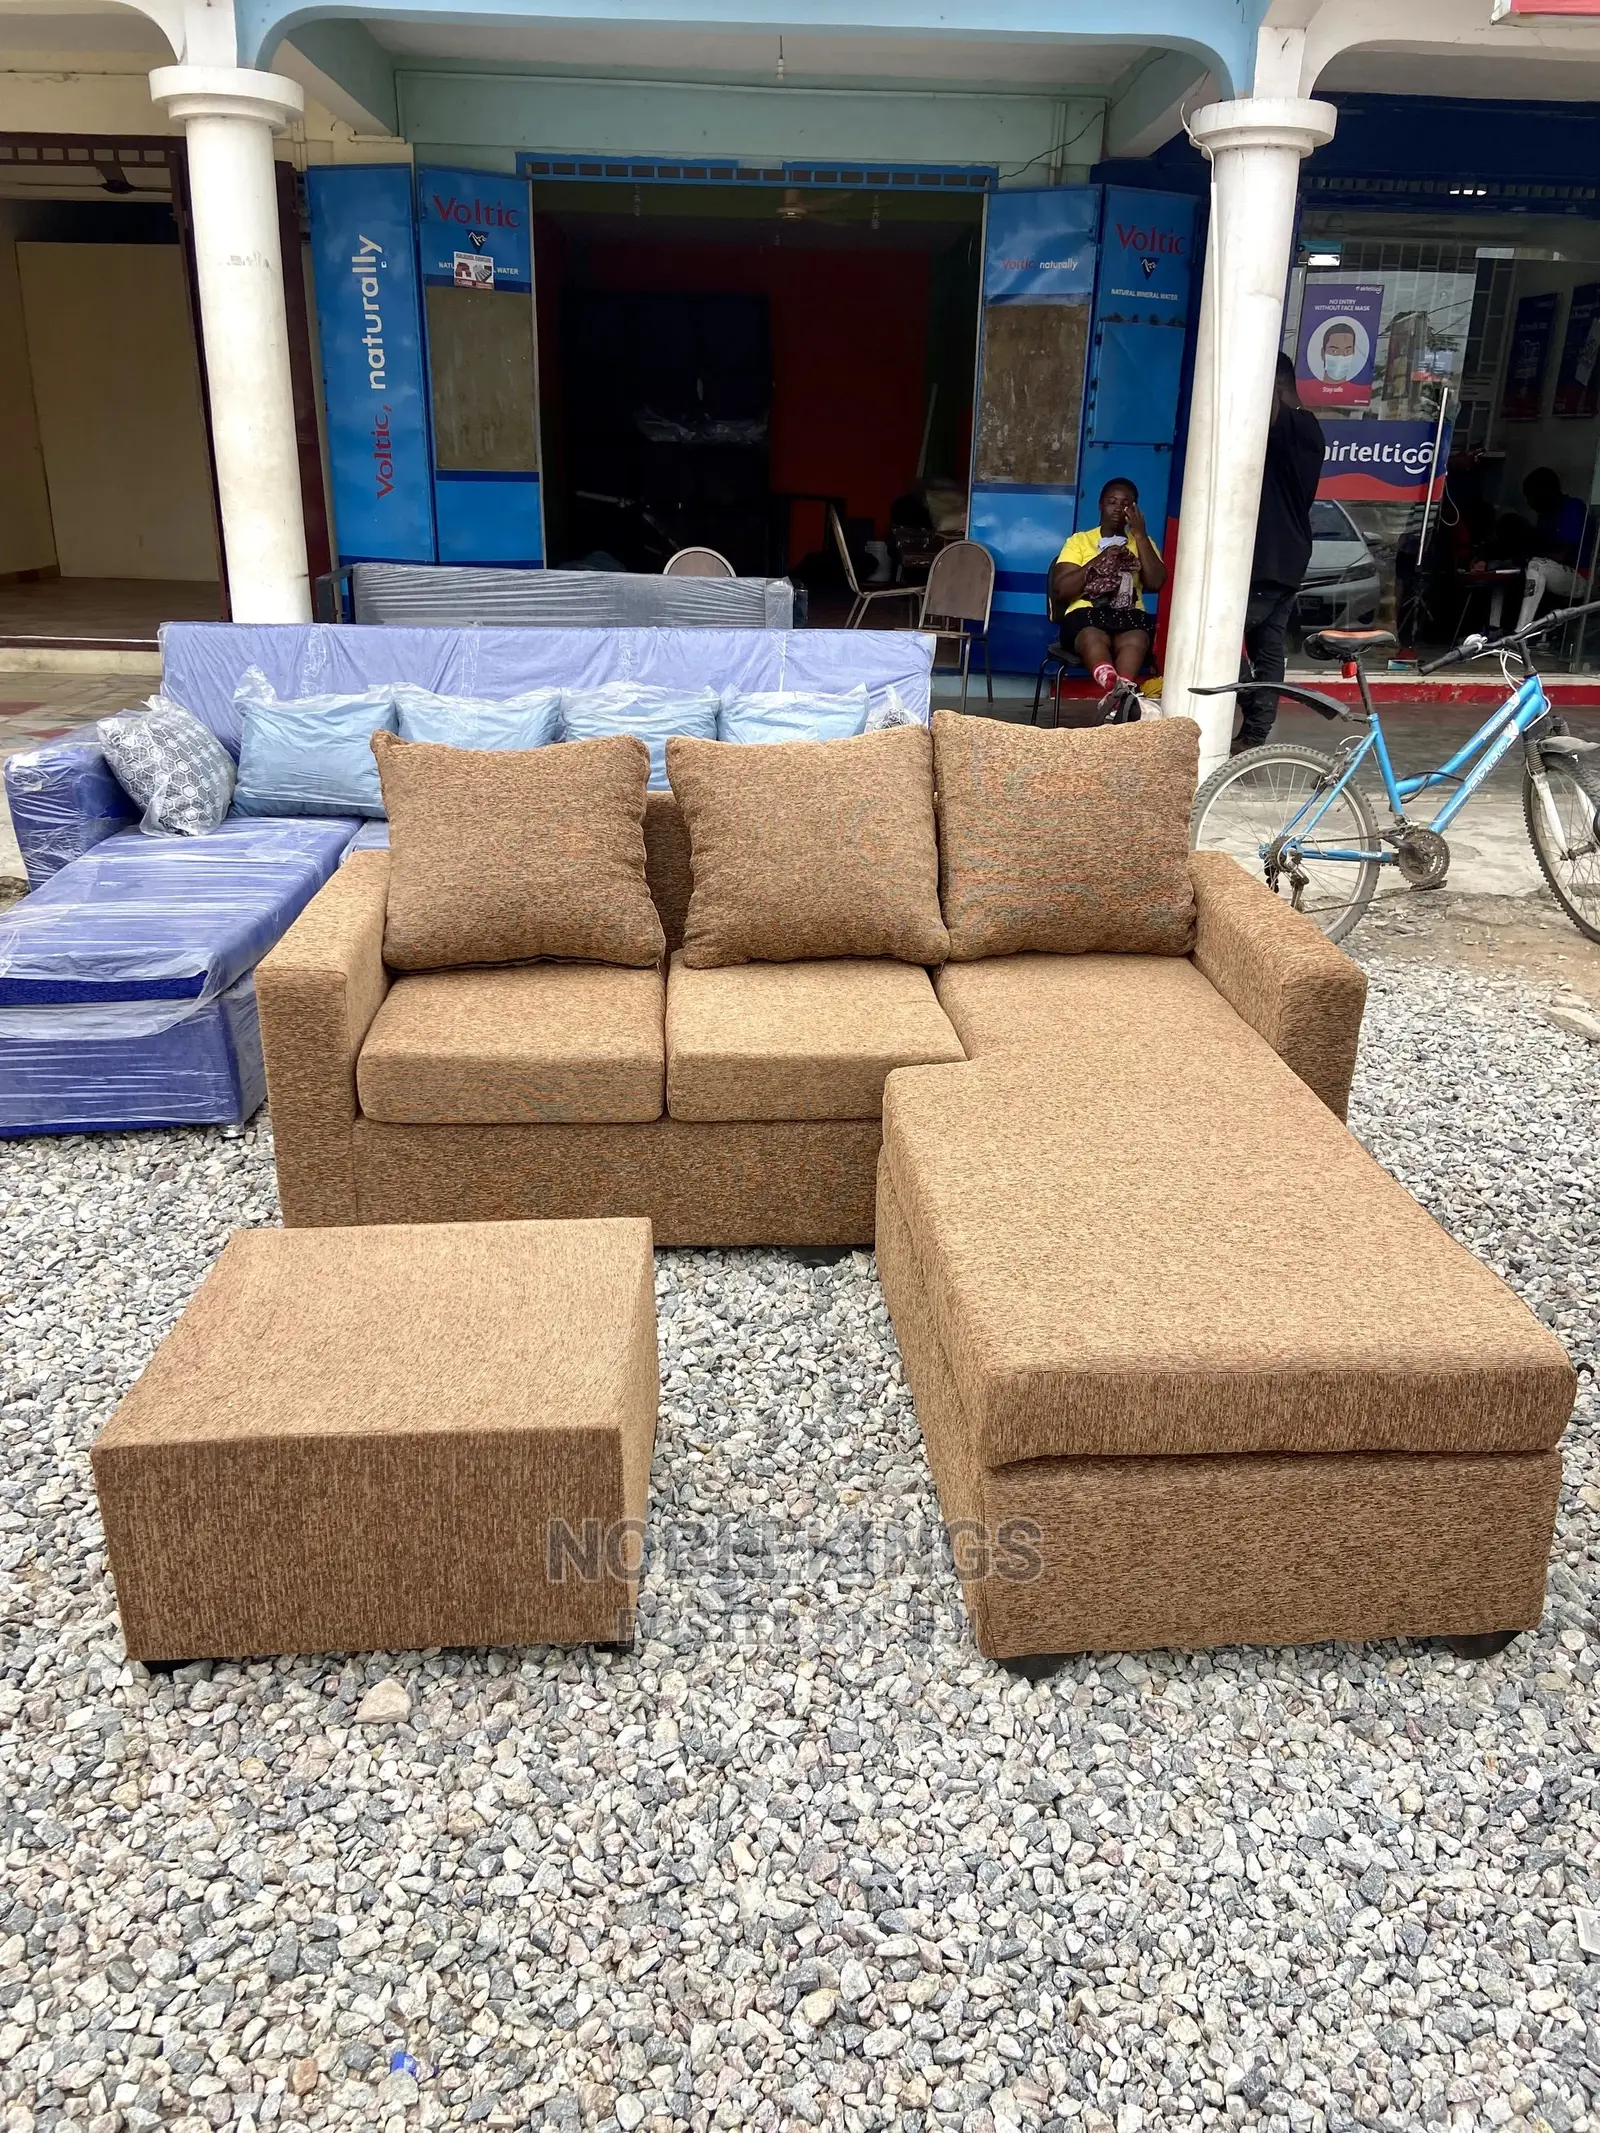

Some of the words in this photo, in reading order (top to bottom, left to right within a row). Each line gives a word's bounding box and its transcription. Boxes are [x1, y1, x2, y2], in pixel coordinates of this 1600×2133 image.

[433, 195, 521, 229] Voltic
[1115, 223, 1187, 255] Voltic
[496, 267, 519, 275] WATER
[1039, 257, 1079, 271] naturally
[1111, 288, 1136, 297] NATURAL
[1136, 290, 1160, 299] MINERAL
[1160, 292, 1178, 301] WATER
[351, 234, 387, 390] naturally
